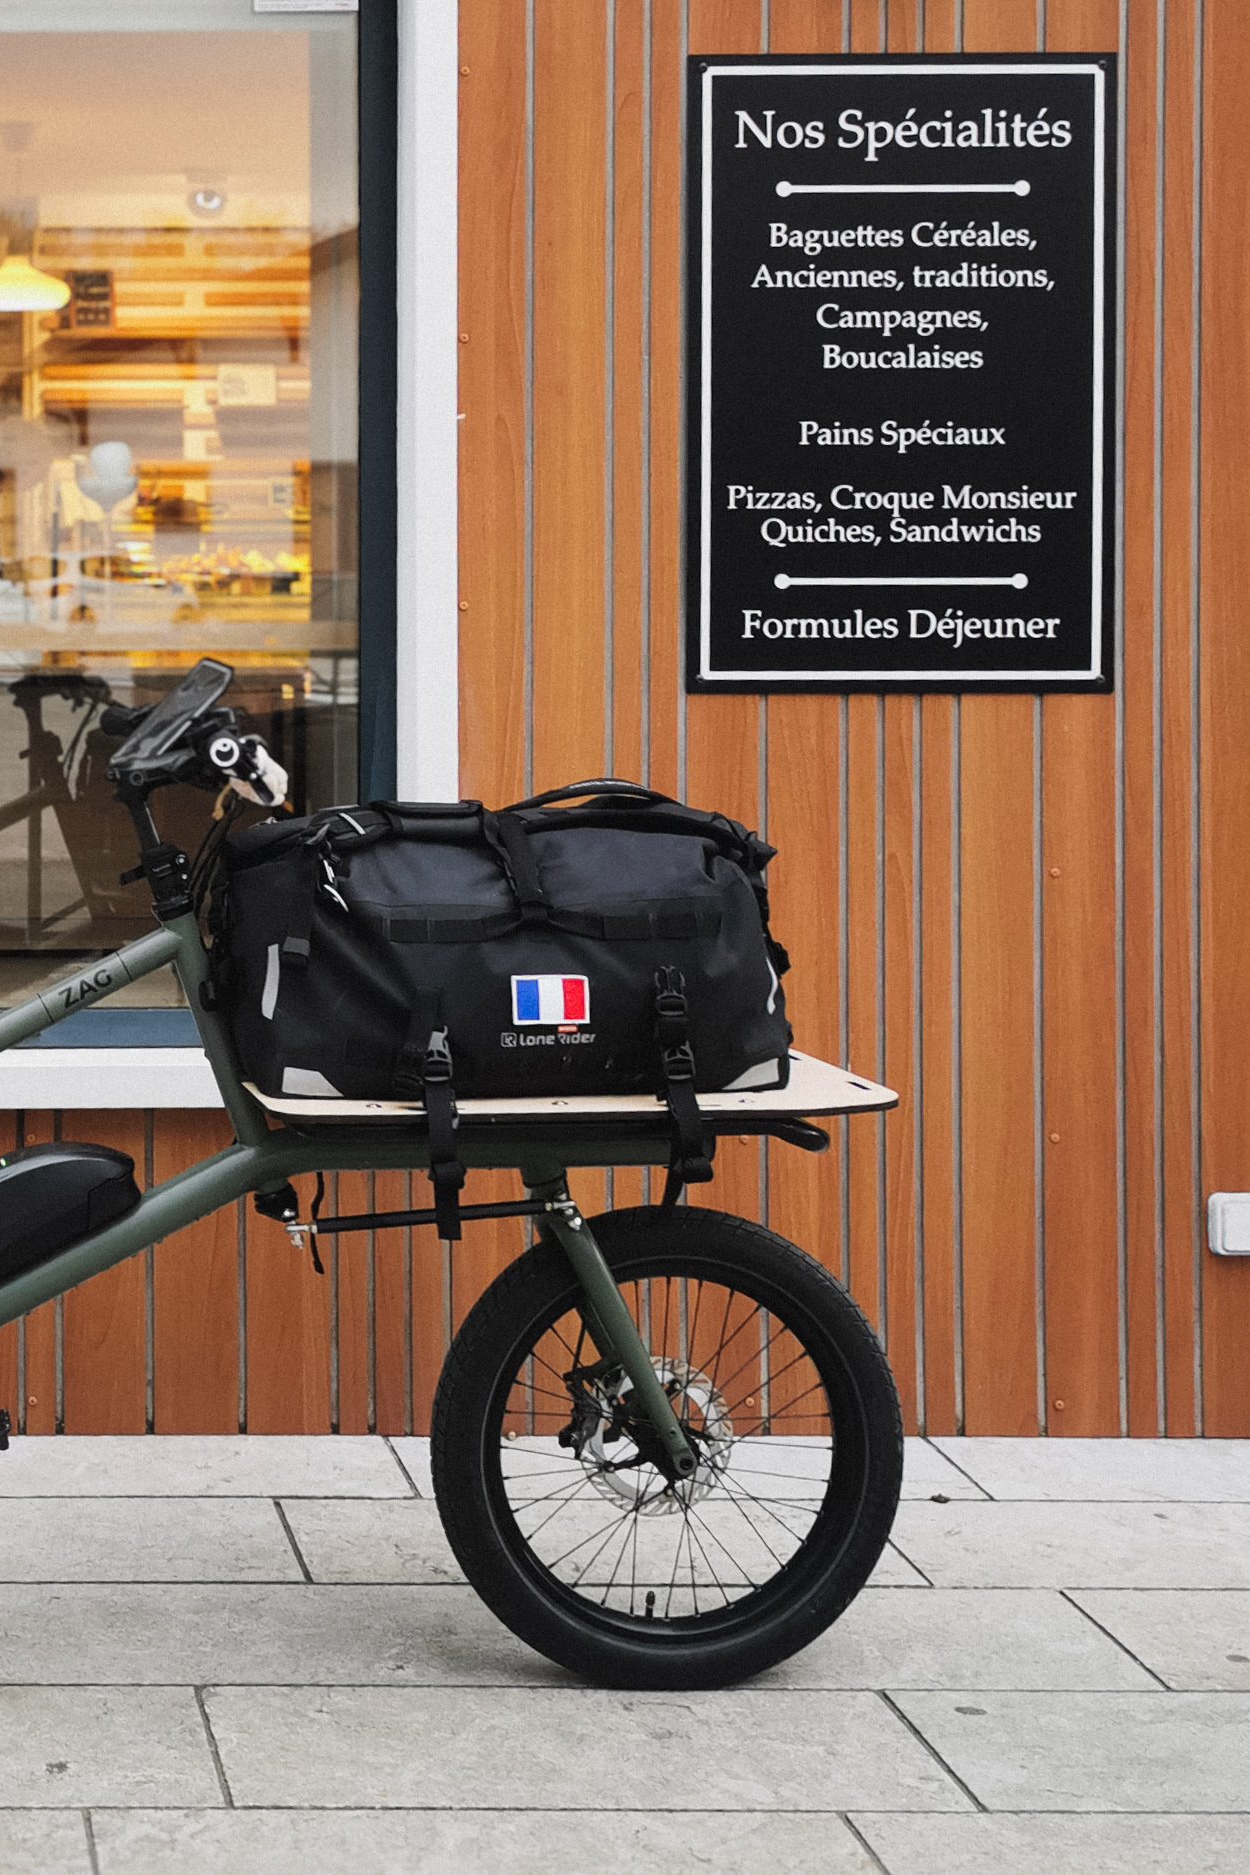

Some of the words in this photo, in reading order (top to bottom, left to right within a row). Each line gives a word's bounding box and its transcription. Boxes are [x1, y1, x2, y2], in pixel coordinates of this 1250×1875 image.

[734, 110, 826, 149] Nos
[837, 107, 1073, 162] Spécialités
[768, 222, 905, 256] Baguettes
[910, 220, 1037, 251] Céréales,
[750, 263, 905, 292] Anciennes,
[912, 261, 1055, 292] traditions,
[816, 303, 989, 337] Campagnes,
[821, 343, 984, 369] Boucalaises
[798, 420, 874, 446] Pains
[880, 419, 1006, 454] Spéciaux
[726, 485, 823, 514] Pizzas,
[830, 484, 935, 519] Croque
[941, 484, 1078, 510] Monsieur
[760, 517, 882, 548] Quiches,
[889, 515, 1042, 543] Sandwichs
[741, 608, 899, 639] Formules
[907, 608, 1061, 649] Déjeuner
[58, 969, 112, 1008] ZAG
[519, 1033, 555, 1046] Lone
[558, 1033, 597, 1045] Rider
